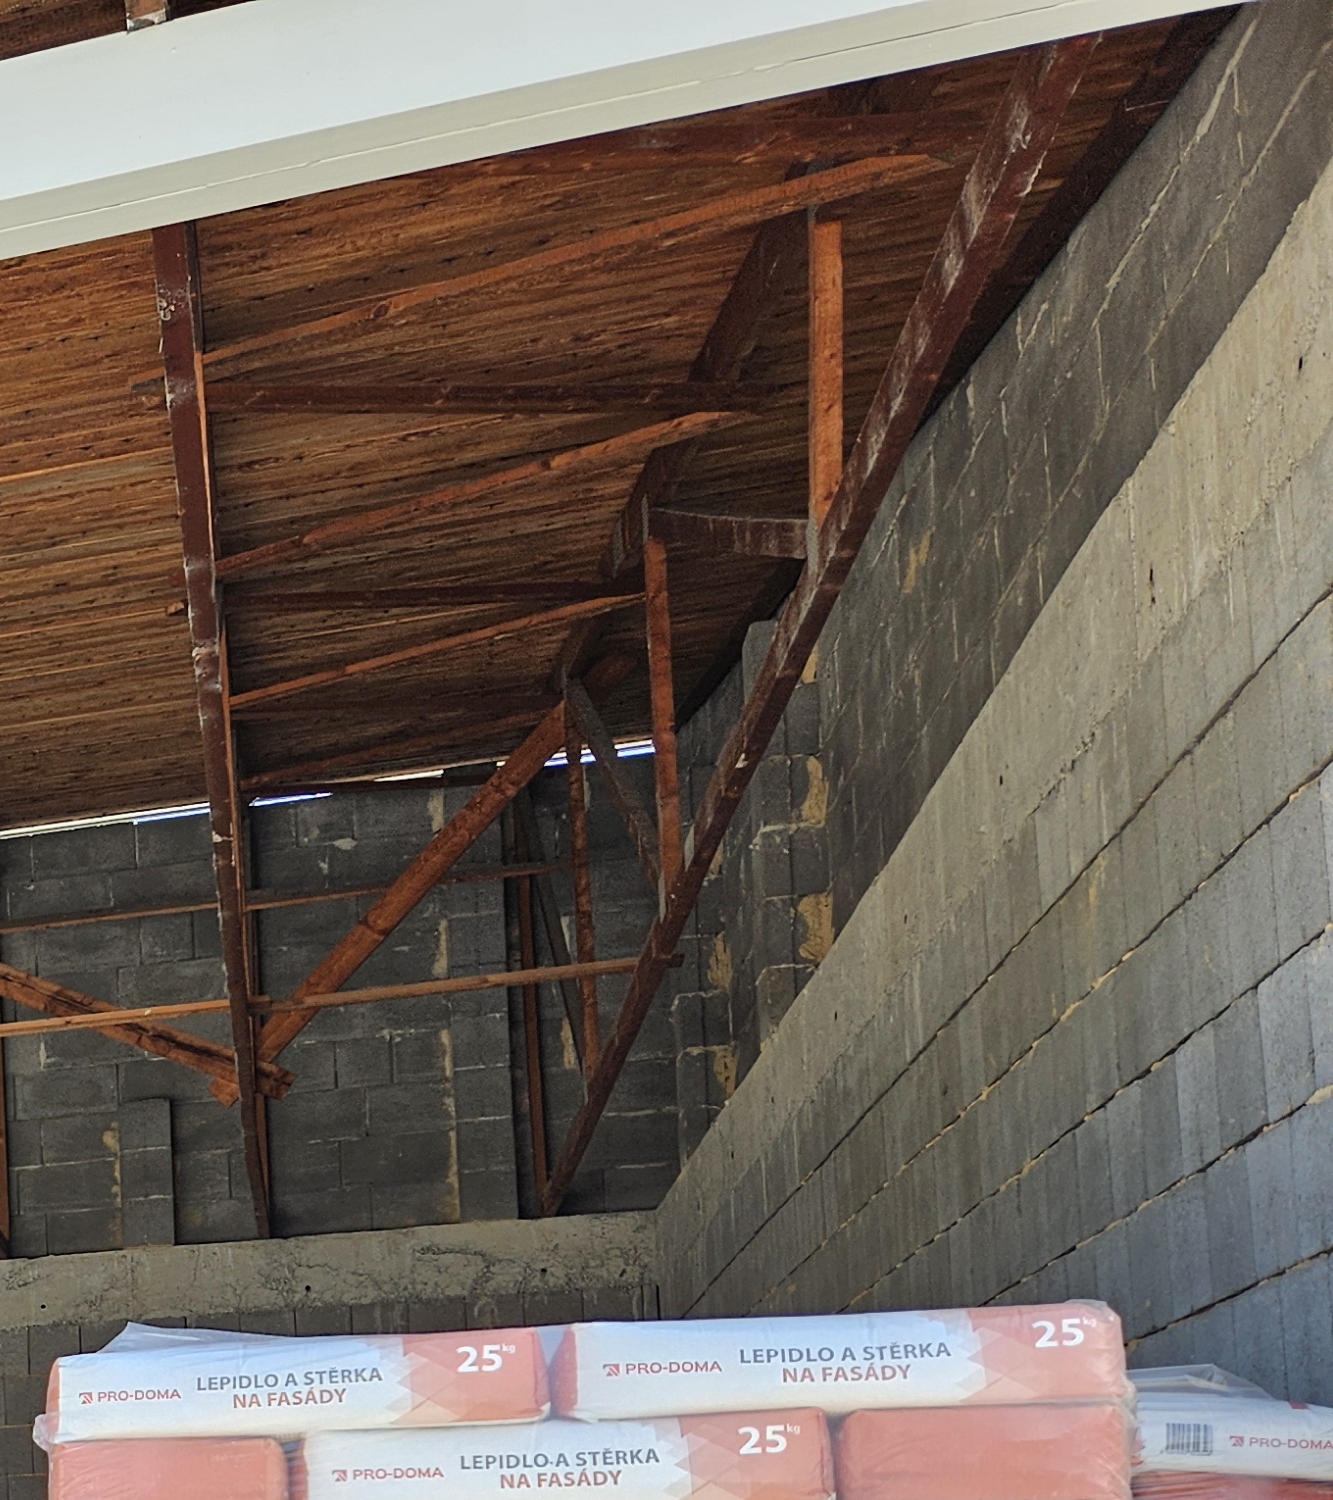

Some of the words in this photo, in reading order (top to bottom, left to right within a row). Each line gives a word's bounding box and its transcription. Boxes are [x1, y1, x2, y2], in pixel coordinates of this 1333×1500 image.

[626, 1361, 722, 1374] PRO-DOMA
[740, 1347, 834, 1363] LEPIDLO
[841, 1347, 856, 1361] A
[863, 1342, 951, 1360] STĚRKA
[98, 1389, 181, 1402] PRO-DOMA
[197, 1374, 278, 1390] LEPIDLO
[285, 1373, 298, 1387] A
[304, 1367, 382, 1387] STĚRKA
[783, 1368, 815, 1382] NA
[822, 1363, 910, 1382] FASÁDY
[234, 1394, 261, 1408] NA
[267, 1385, 346, 1406] FASÁDY
[353, 1467, 444, 1480] PRO-DOMA
[461, 1454, 548, 1469] LEPIDLO
[556, 1453, 569, 1467] A
[576, 1448, 659, 1466] STĚRKA
[501, 1474, 529, 1488] NA
[538, 1468, 621, 1487] FASÁDY
